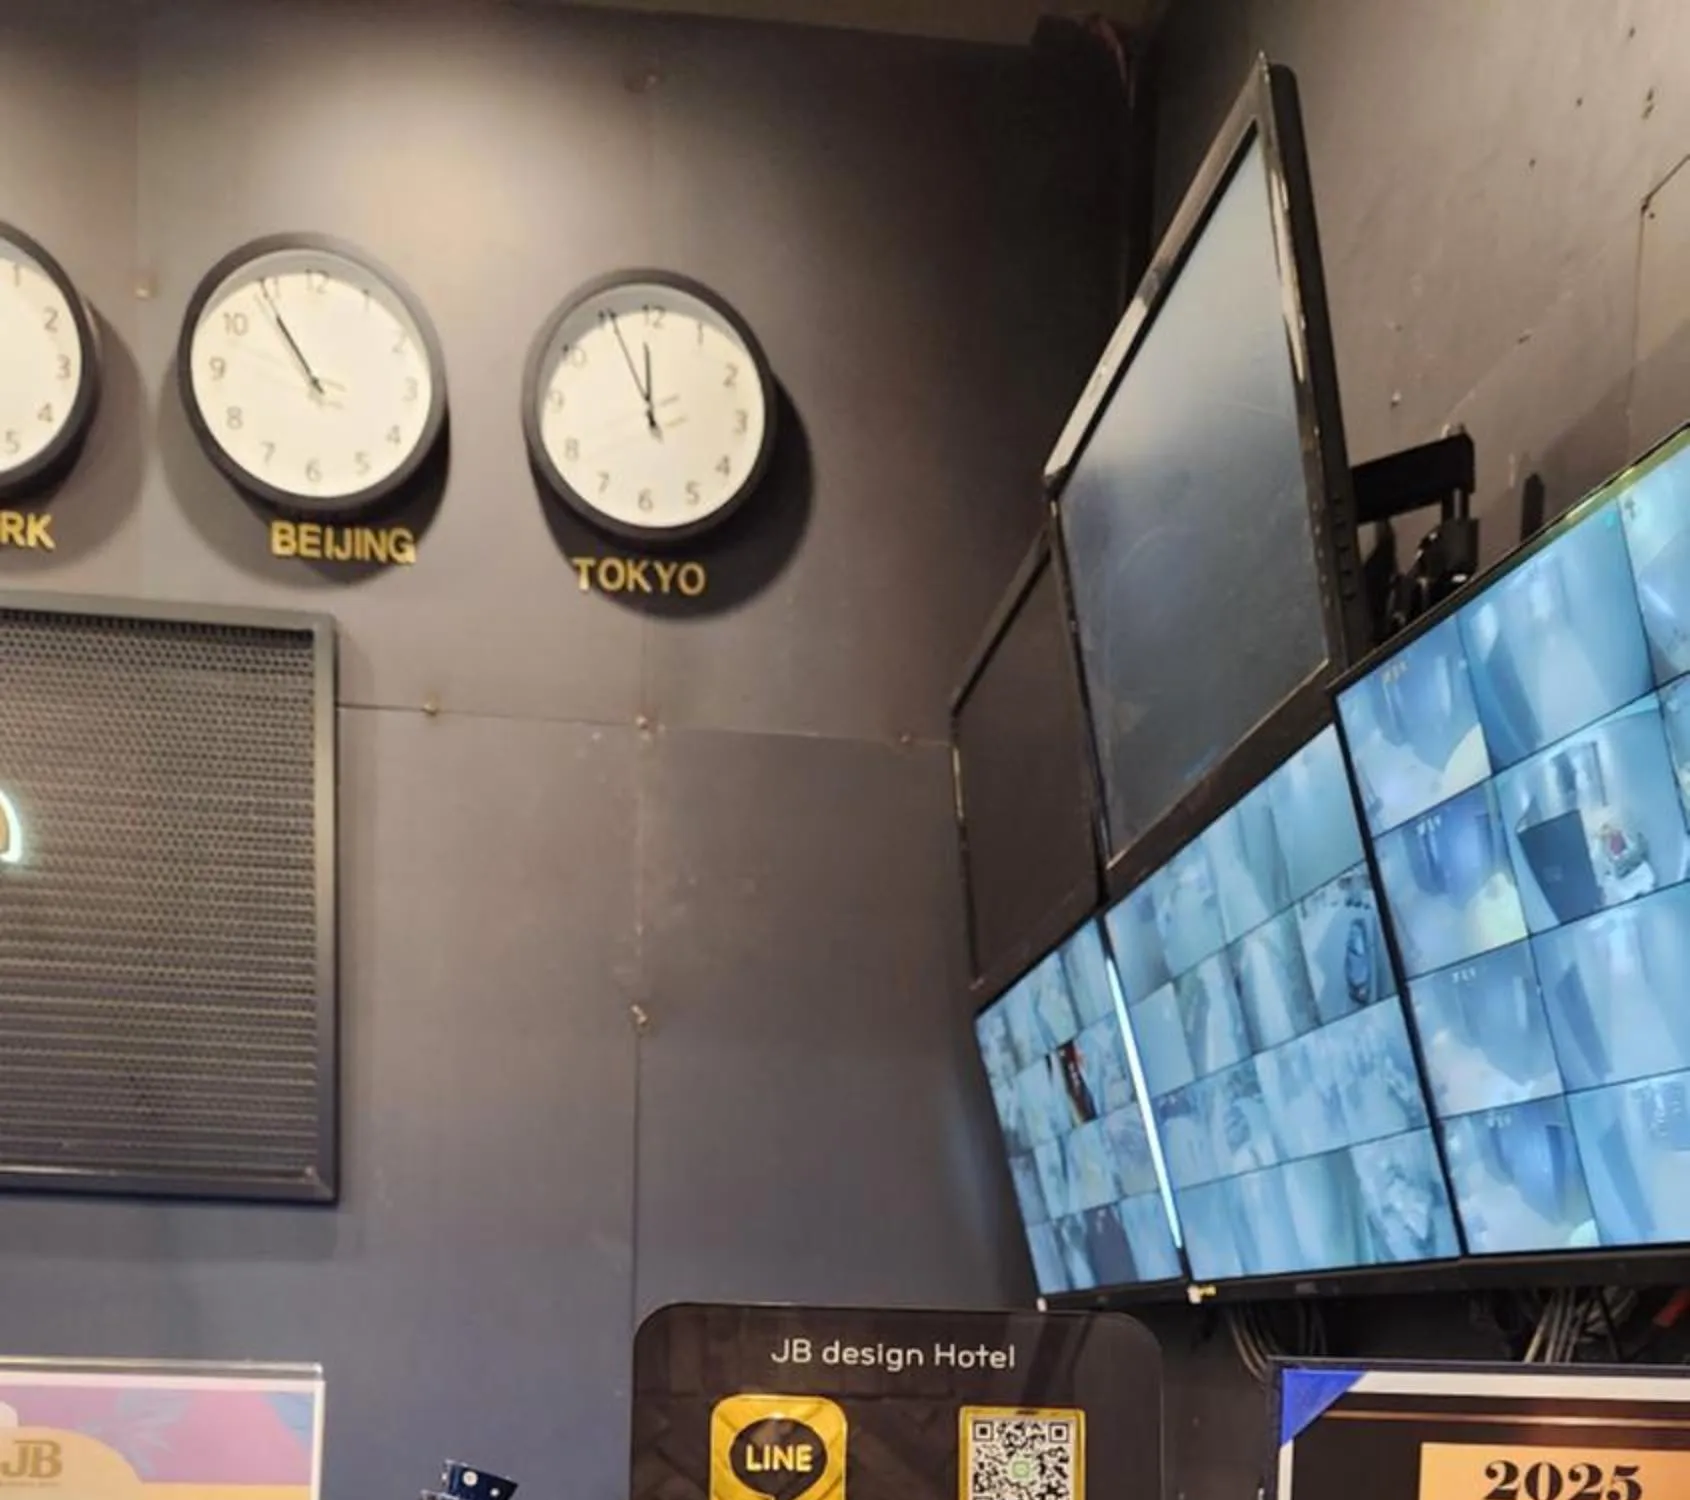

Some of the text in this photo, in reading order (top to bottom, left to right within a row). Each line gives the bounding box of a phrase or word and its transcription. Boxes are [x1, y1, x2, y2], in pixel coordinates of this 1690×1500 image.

[305, 269, 329, 294] 12
[44, 308, 58, 332] 2
[223, 312, 248, 337] 10
[641, 303, 666, 329] 12
[56, 355, 71, 379] 3
[209, 357, 225, 380] 9
[722, 363, 738, 388] 2
[37, 404, 53, 423] 4
[226, 407, 244, 431] 8
[735, 410, 749, 436] 3
[5, 430, 20, 455] 5
[386, 426, 401, 446] 4
[260, 442, 275, 465] 7
[565, 437, 579, 461] 8
[305, 458, 321, 483] 6
[355, 452, 370, 476] 5
[715, 455, 730, 479] 4
[598, 471, 610, 493] 7
[685, 480, 700, 505] 5
[638, 488, 653, 511] 6
[270, 520, 416, 564] BEIJING
[572, 557, 706, 595] TOKYO
[771, 1339, 1016, 1371] JB design Hotel
[1, 1439, 62, 1478] JB
[745, 1444, 813, 1472] LINE
